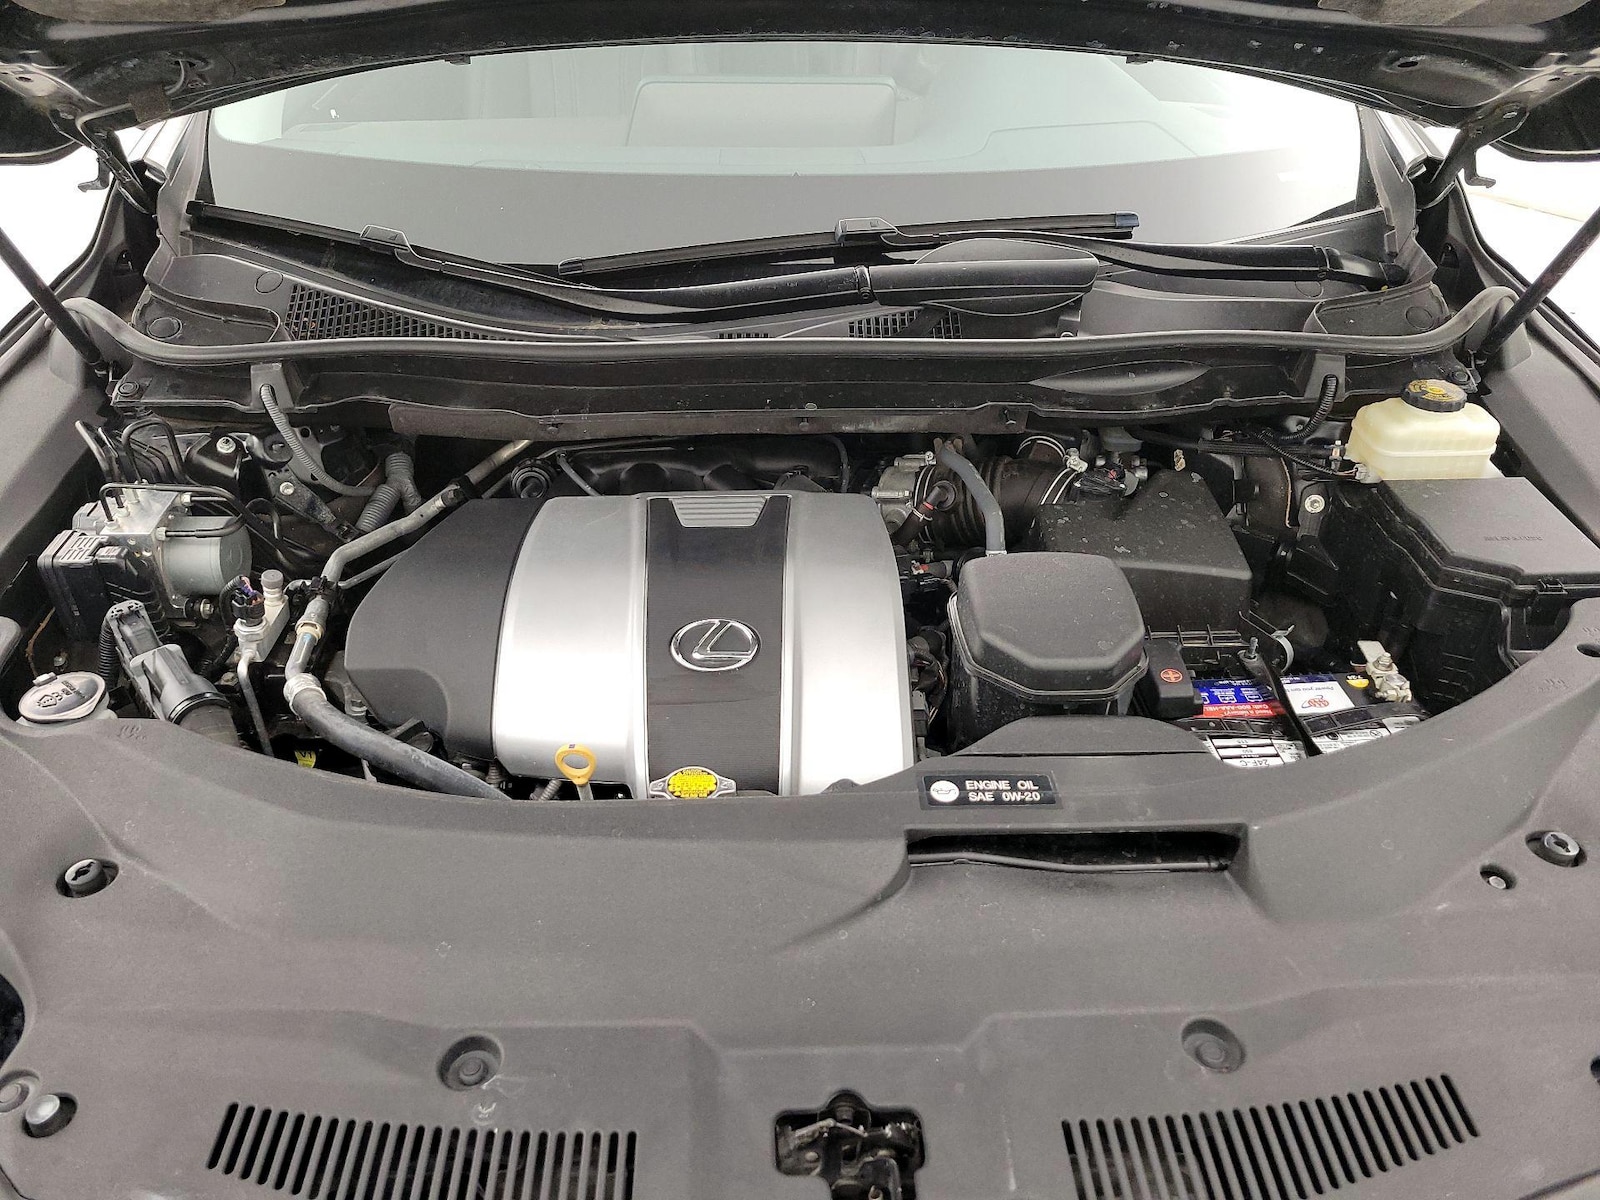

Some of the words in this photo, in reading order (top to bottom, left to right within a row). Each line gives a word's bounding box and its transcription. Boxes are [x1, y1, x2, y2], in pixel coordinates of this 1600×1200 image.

[965, 780, 1011, 790] ENGINE
[1017, 780, 1039, 790] OIL
[968, 791, 995, 802] SAE
[1002, 791, 1041, 802] 0W-20
